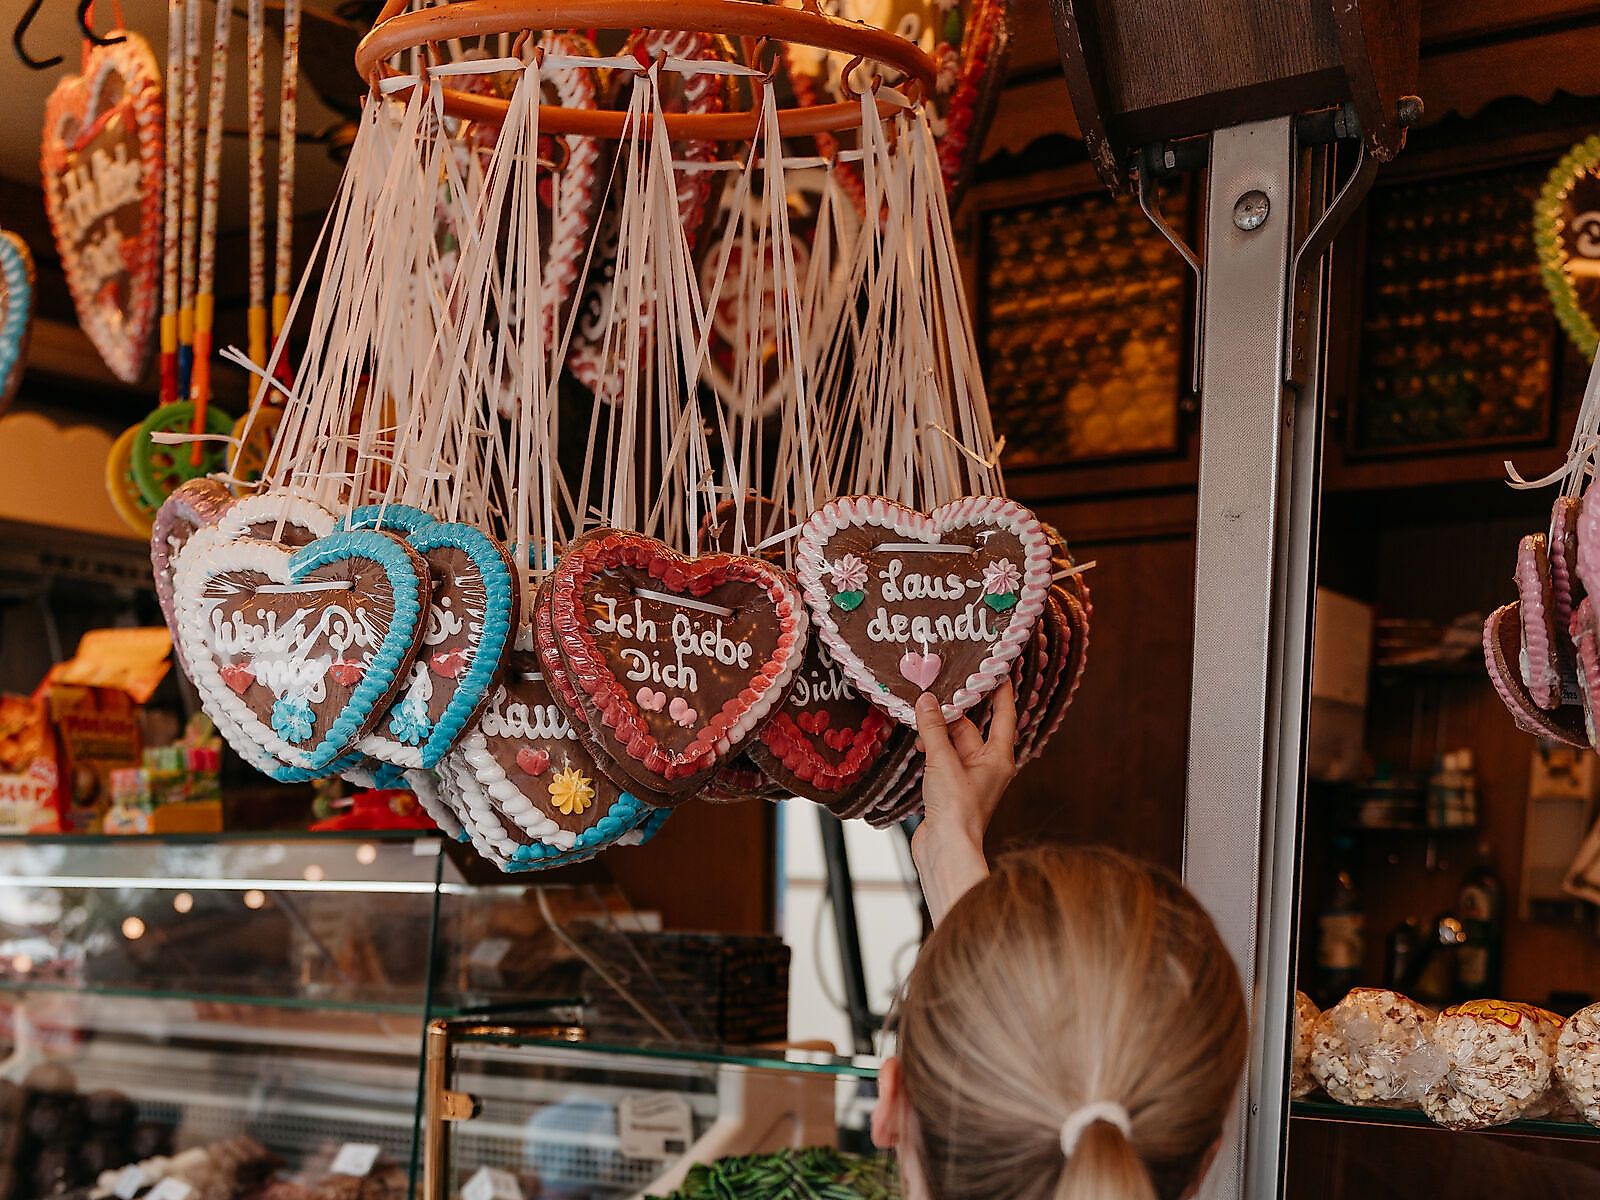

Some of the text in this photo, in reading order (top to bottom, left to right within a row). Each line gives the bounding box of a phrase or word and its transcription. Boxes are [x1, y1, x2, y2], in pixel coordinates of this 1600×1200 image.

[594, 593, 658, 642] Ich
[619, 648, 698, 693] Dich
[481, 684, 579, 741] Lau
